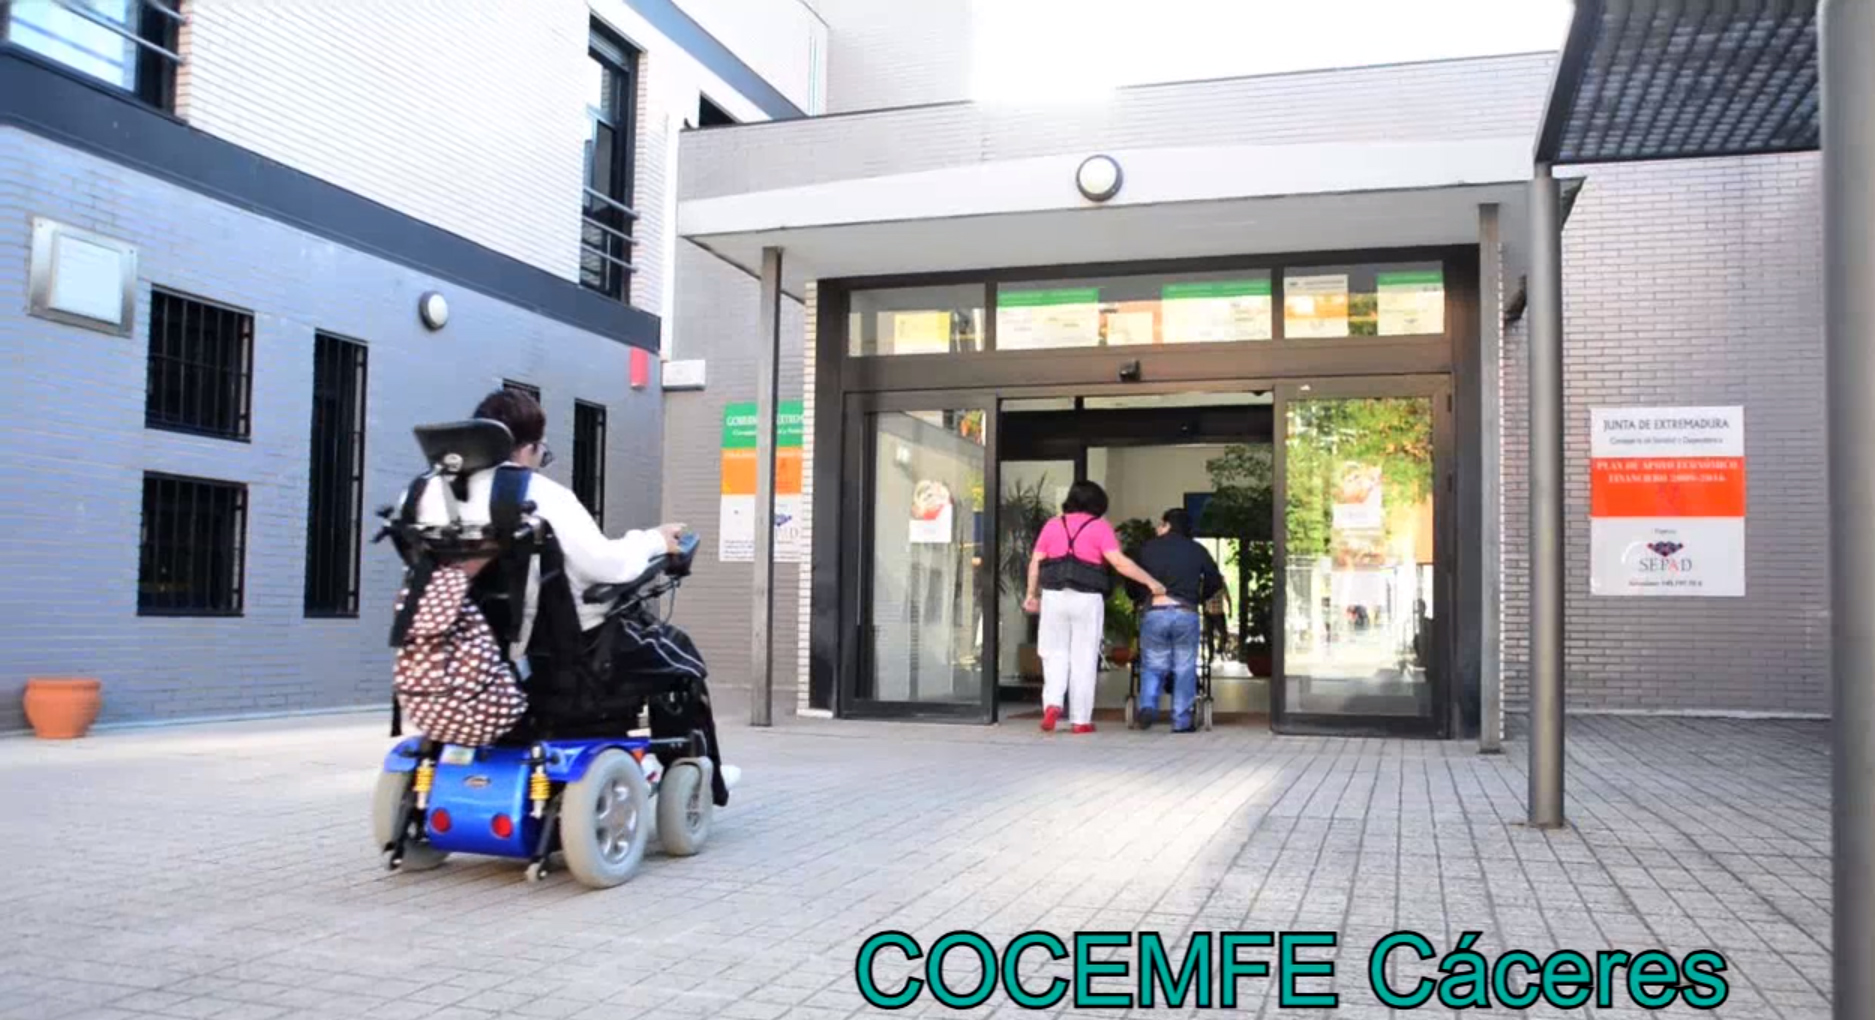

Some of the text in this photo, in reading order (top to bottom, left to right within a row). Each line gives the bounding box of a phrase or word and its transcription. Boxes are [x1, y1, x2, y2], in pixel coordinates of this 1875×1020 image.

[1603, 418, 1730, 432] JUNTA DE EXTREMADURA
[1638, 558, 1693, 573] SEPAD
